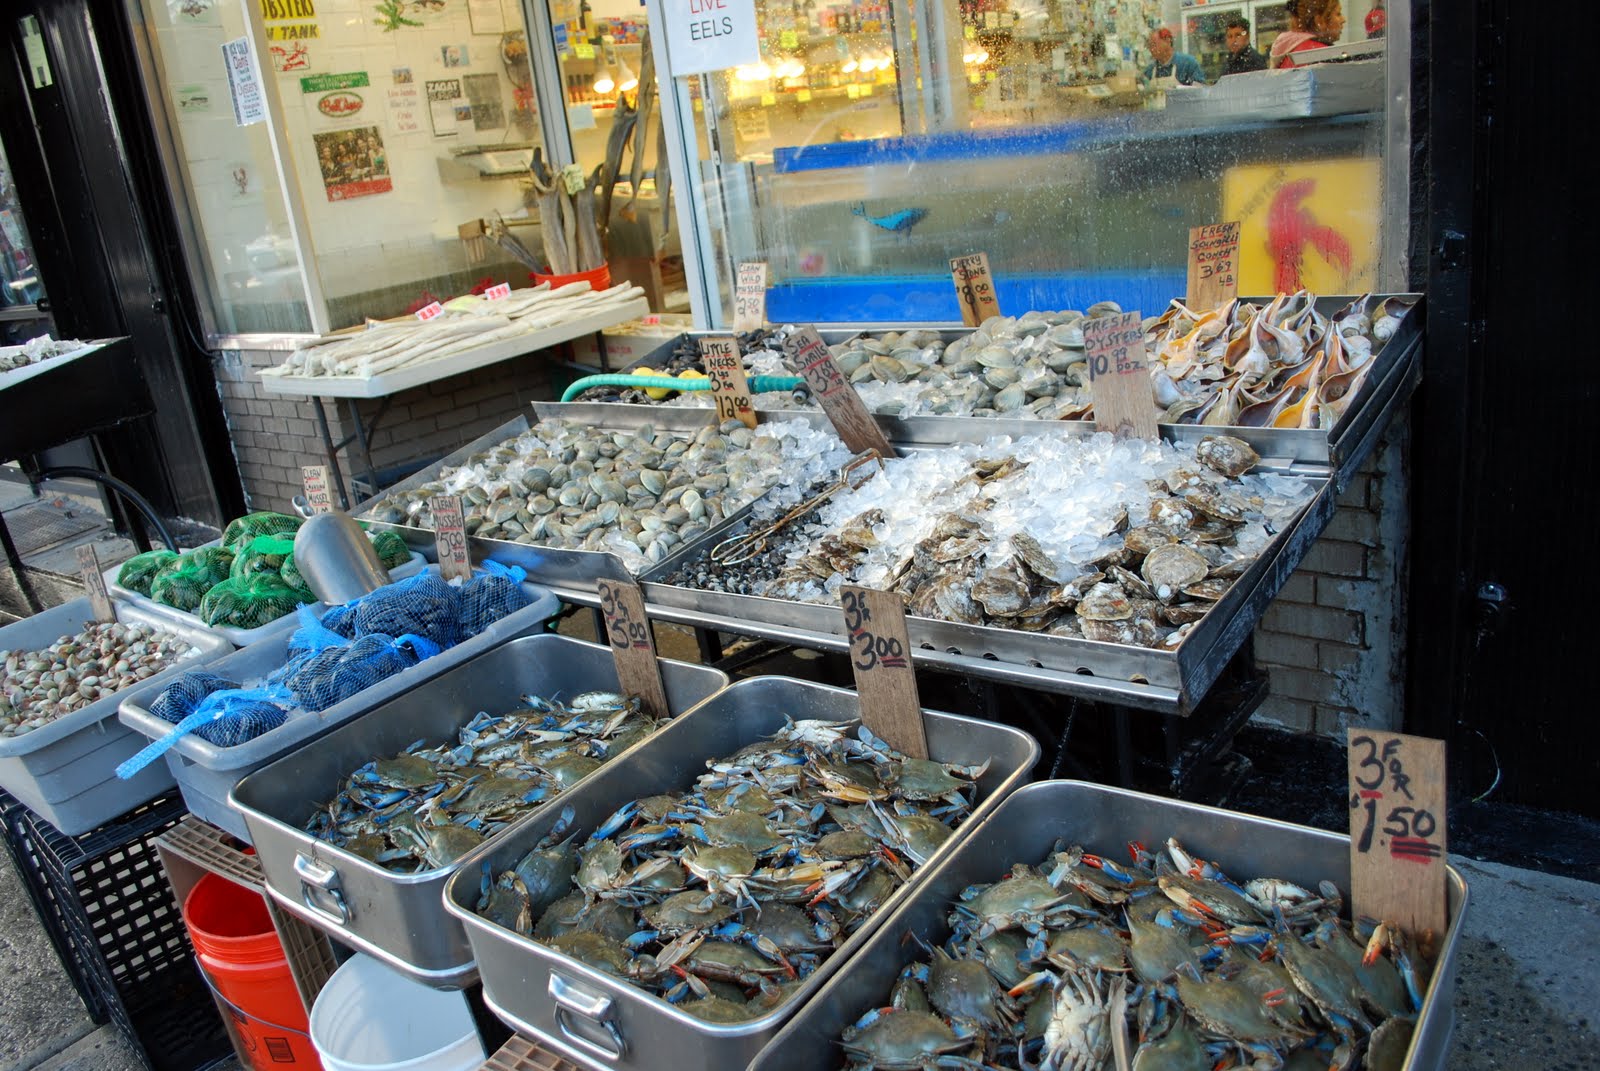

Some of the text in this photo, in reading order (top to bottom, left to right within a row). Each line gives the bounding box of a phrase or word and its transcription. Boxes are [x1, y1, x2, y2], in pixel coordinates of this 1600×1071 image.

[280, 24, 319, 39] TANK
[691, 16, 733, 41] EELS
[427, 81, 458, 92] ZAGAT
[1201, 223, 1235, 237] FRESH
[739, 263, 760, 273] CLEAN
[951, 255, 981, 273] CHERRY
[741, 275, 761, 283] WILD
[959, 266, 986, 280] STONE
[1219, 276, 1233, 284] LB
[737, 285, 765, 293] MUSSELS
[1083, 313, 1132, 337] FRESH
[786, 336, 811, 355] SEA
[1085, 327, 1143, 351] OYSTERS
[701, 341, 732, 356] LITTLE
[709, 357, 737, 368] NECKS
[708, 371, 722, 392] 3
[432, 497, 454, 510] CLEAN
[433, 513, 462, 527] MUSSELS
[598, 583, 616, 616] 3
[841, 591, 862, 631] 3
[1351, 736, 1415, 801] 3 FOR
